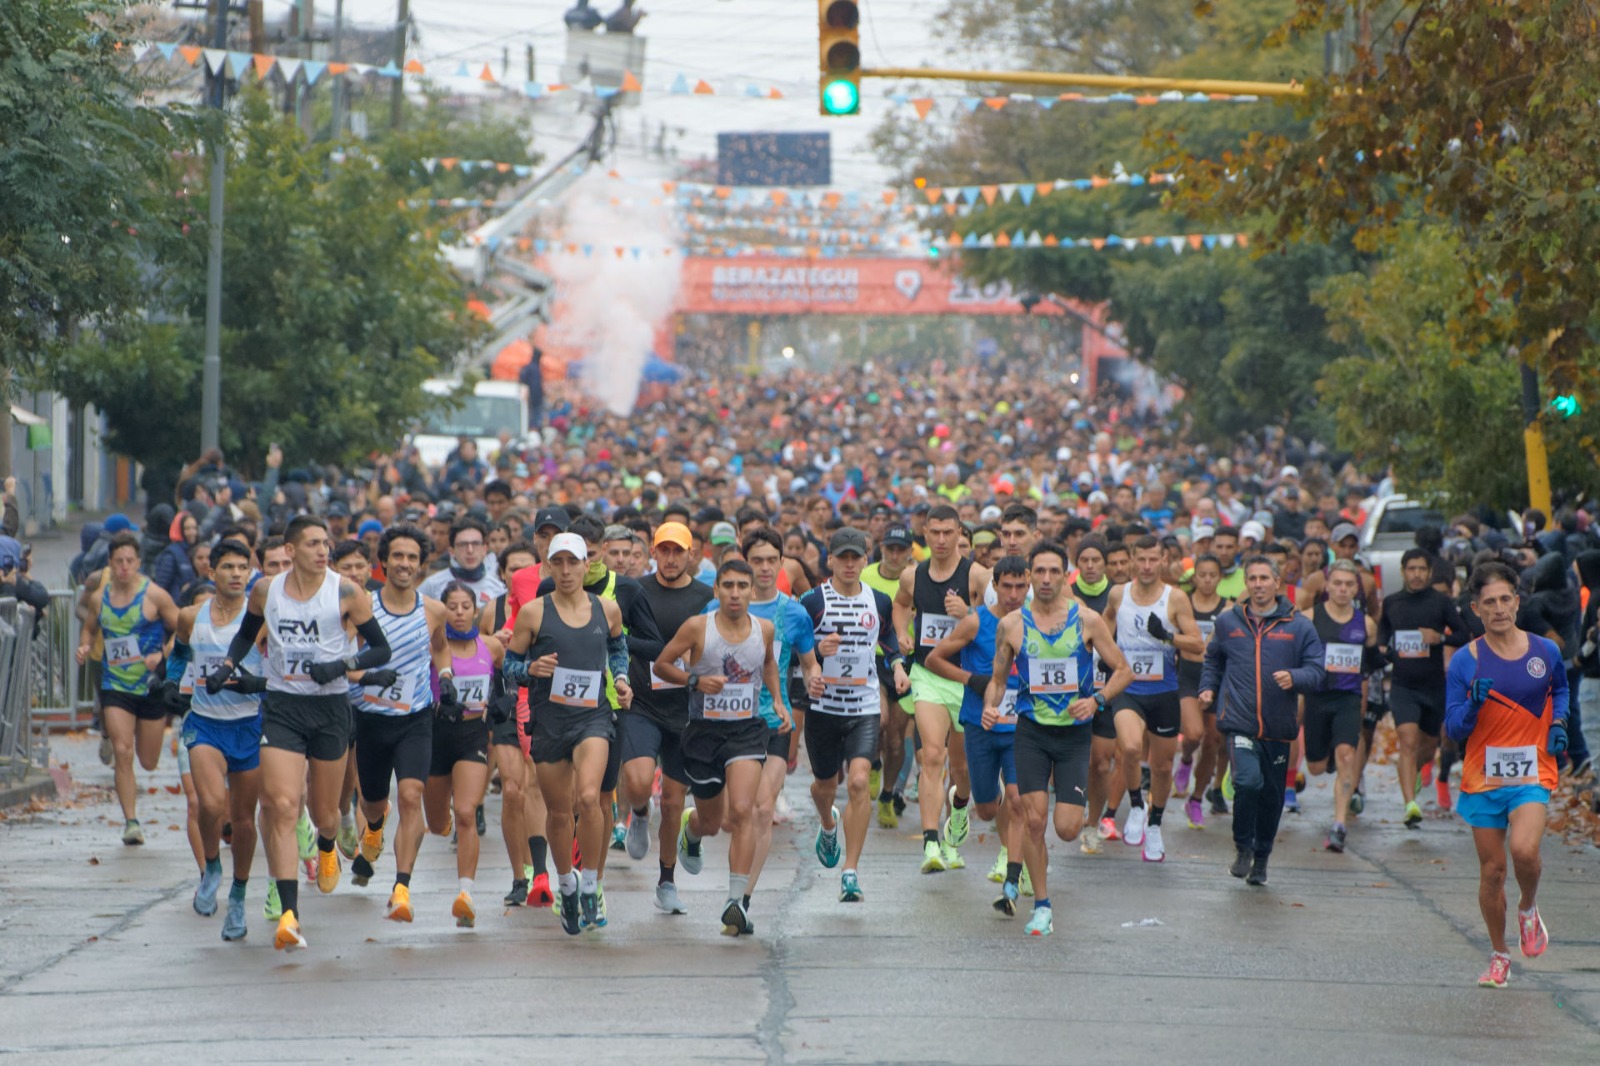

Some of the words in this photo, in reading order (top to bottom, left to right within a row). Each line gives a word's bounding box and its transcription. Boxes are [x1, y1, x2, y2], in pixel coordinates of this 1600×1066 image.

[713, 267, 858, 285] BERAZATEGUI
[112, 645, 130, 659] 24
[287, 660, 313, 675] 76
[1133, 661, 1154, 674] 67
[1327, 654, 1359, 667] 3395
[841, 664, 853, 678] 2
[1041, 670, 1066, 685] 18
[377, 685, 402, 701] 75
[460, 687, 482, 702] 74
[563, 682, 590, 699] 87
[705, 697, 751, 712] 3400
[1492, 760, 1533, 777] 137
